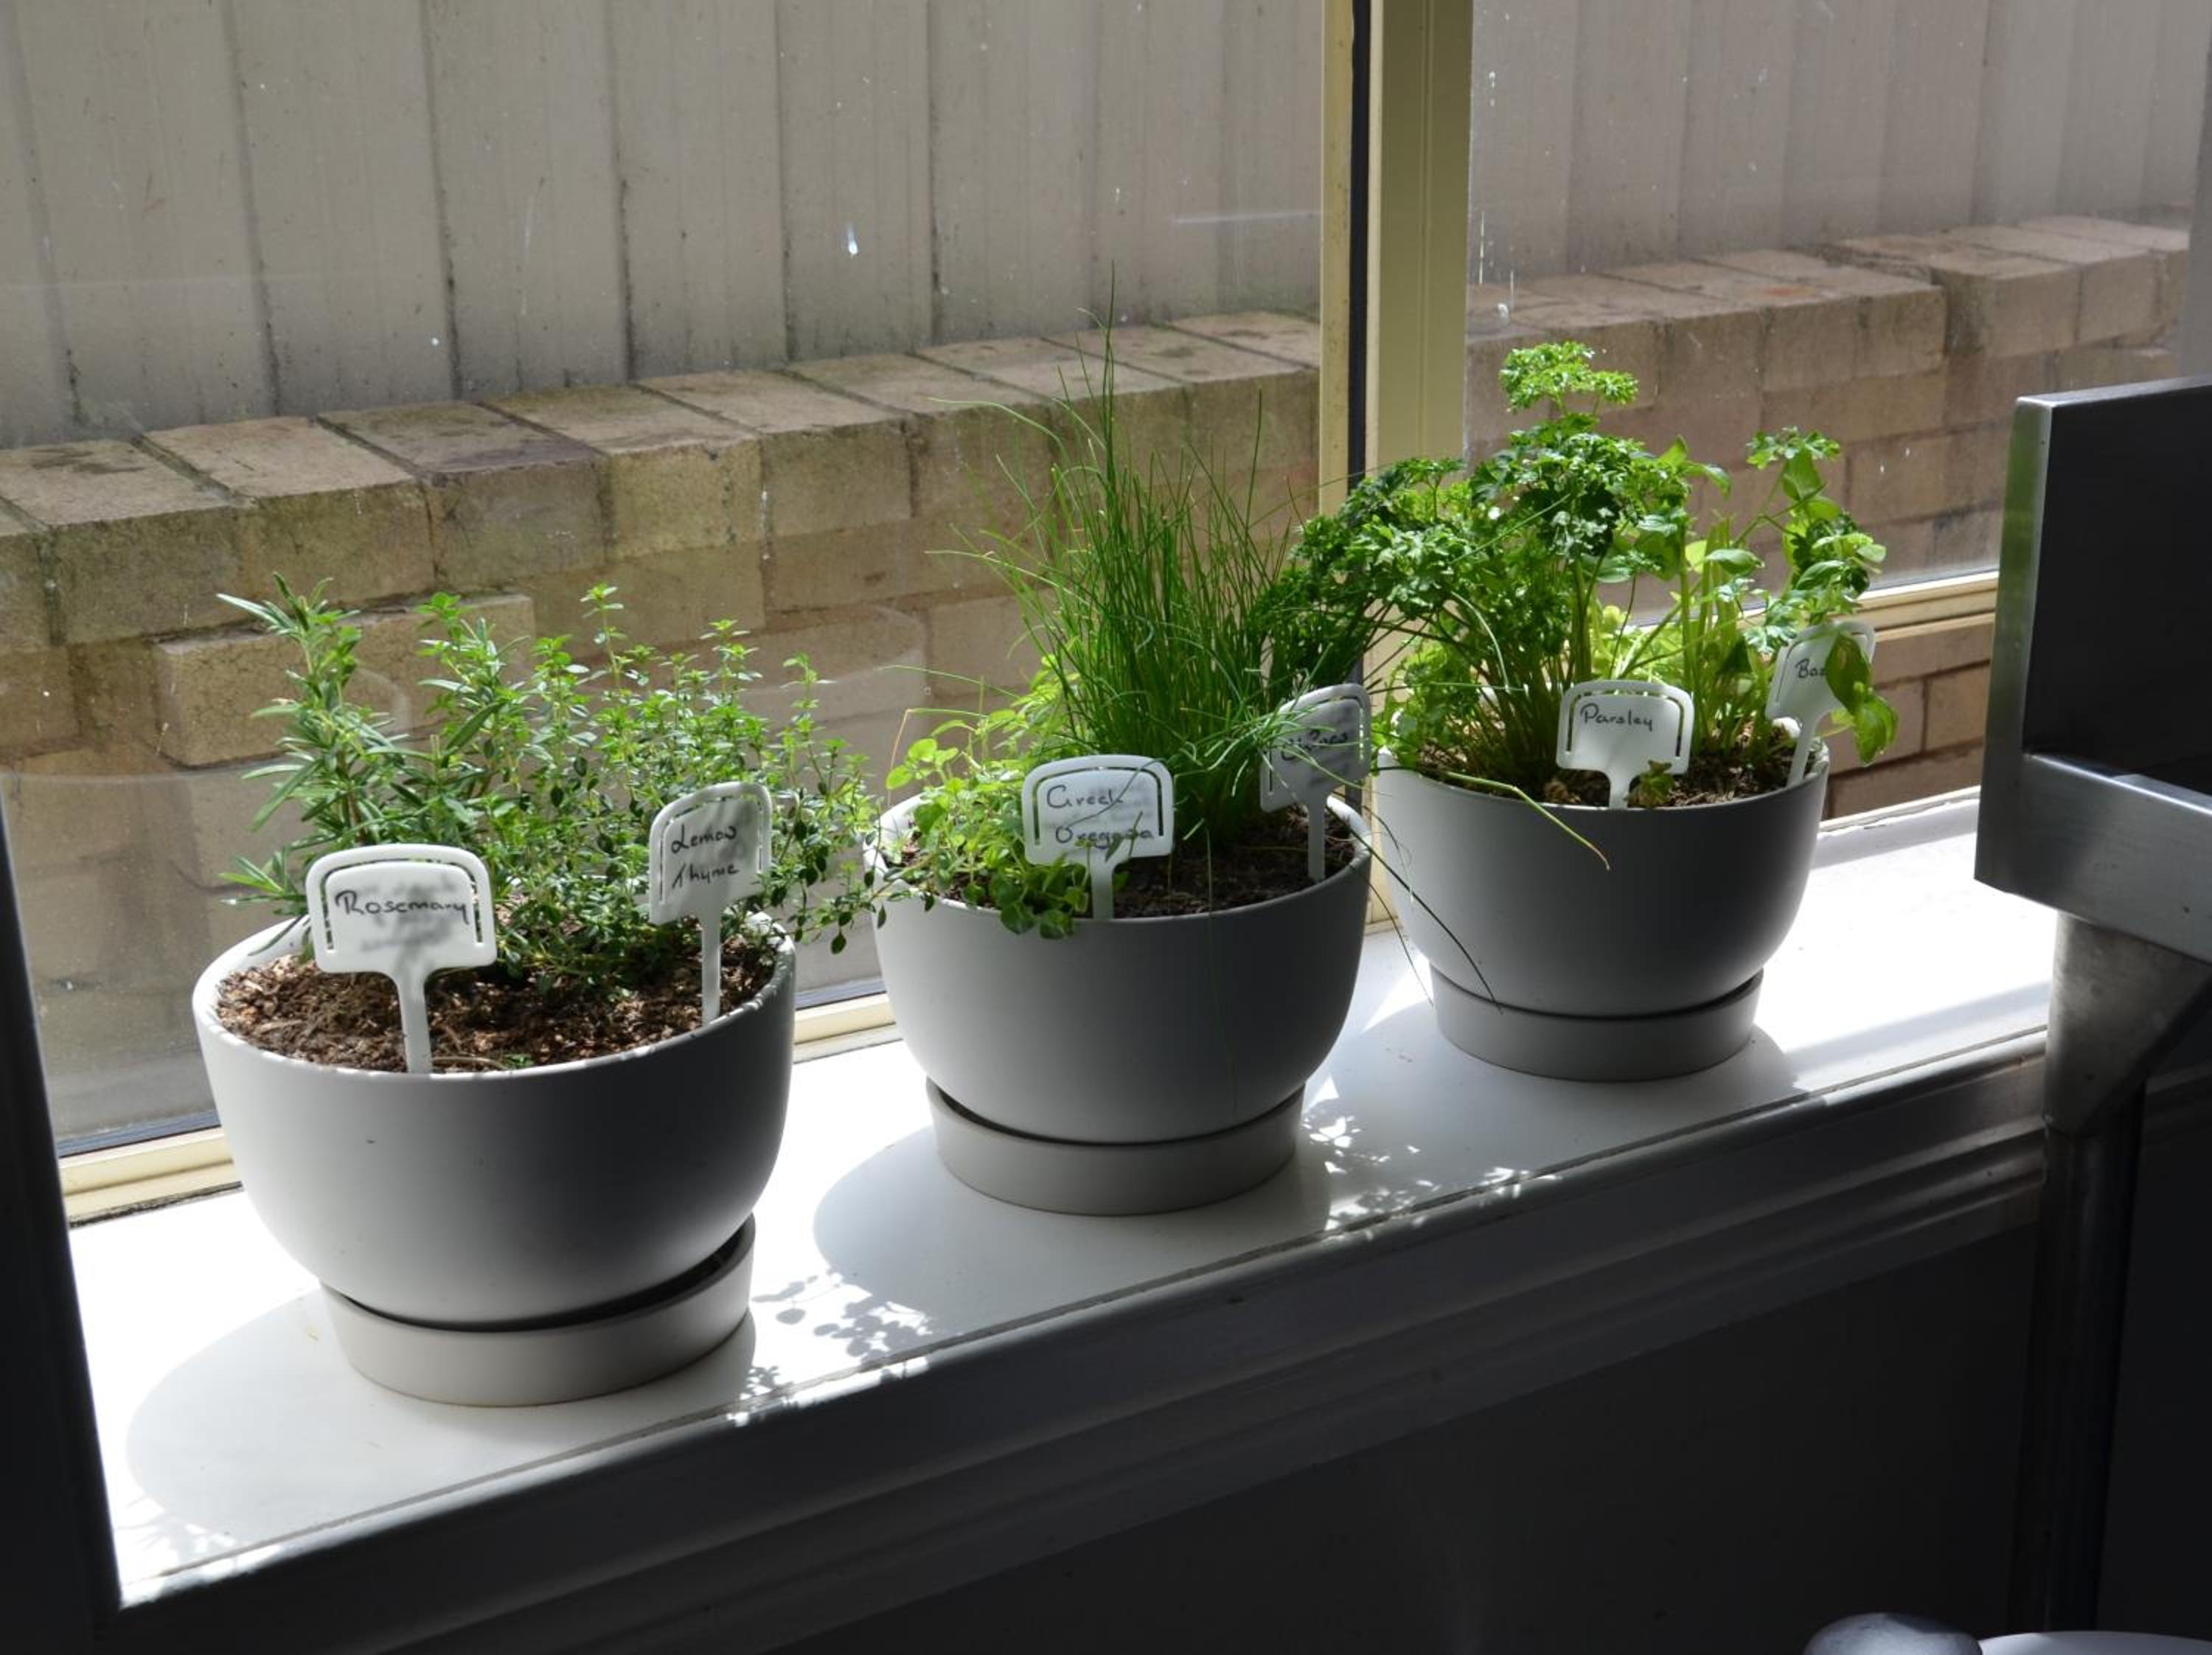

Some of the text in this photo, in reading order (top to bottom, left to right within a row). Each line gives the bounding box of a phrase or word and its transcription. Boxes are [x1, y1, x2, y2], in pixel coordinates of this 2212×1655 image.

[1580, 703, 1652, 732] Parsley
[1046, 785, 1123, 808] Greek
[670, 823, 737, 854] Lemon
[672, 862, 739, 889] Thyme
[334, 889, 470, 926] Rosemary
